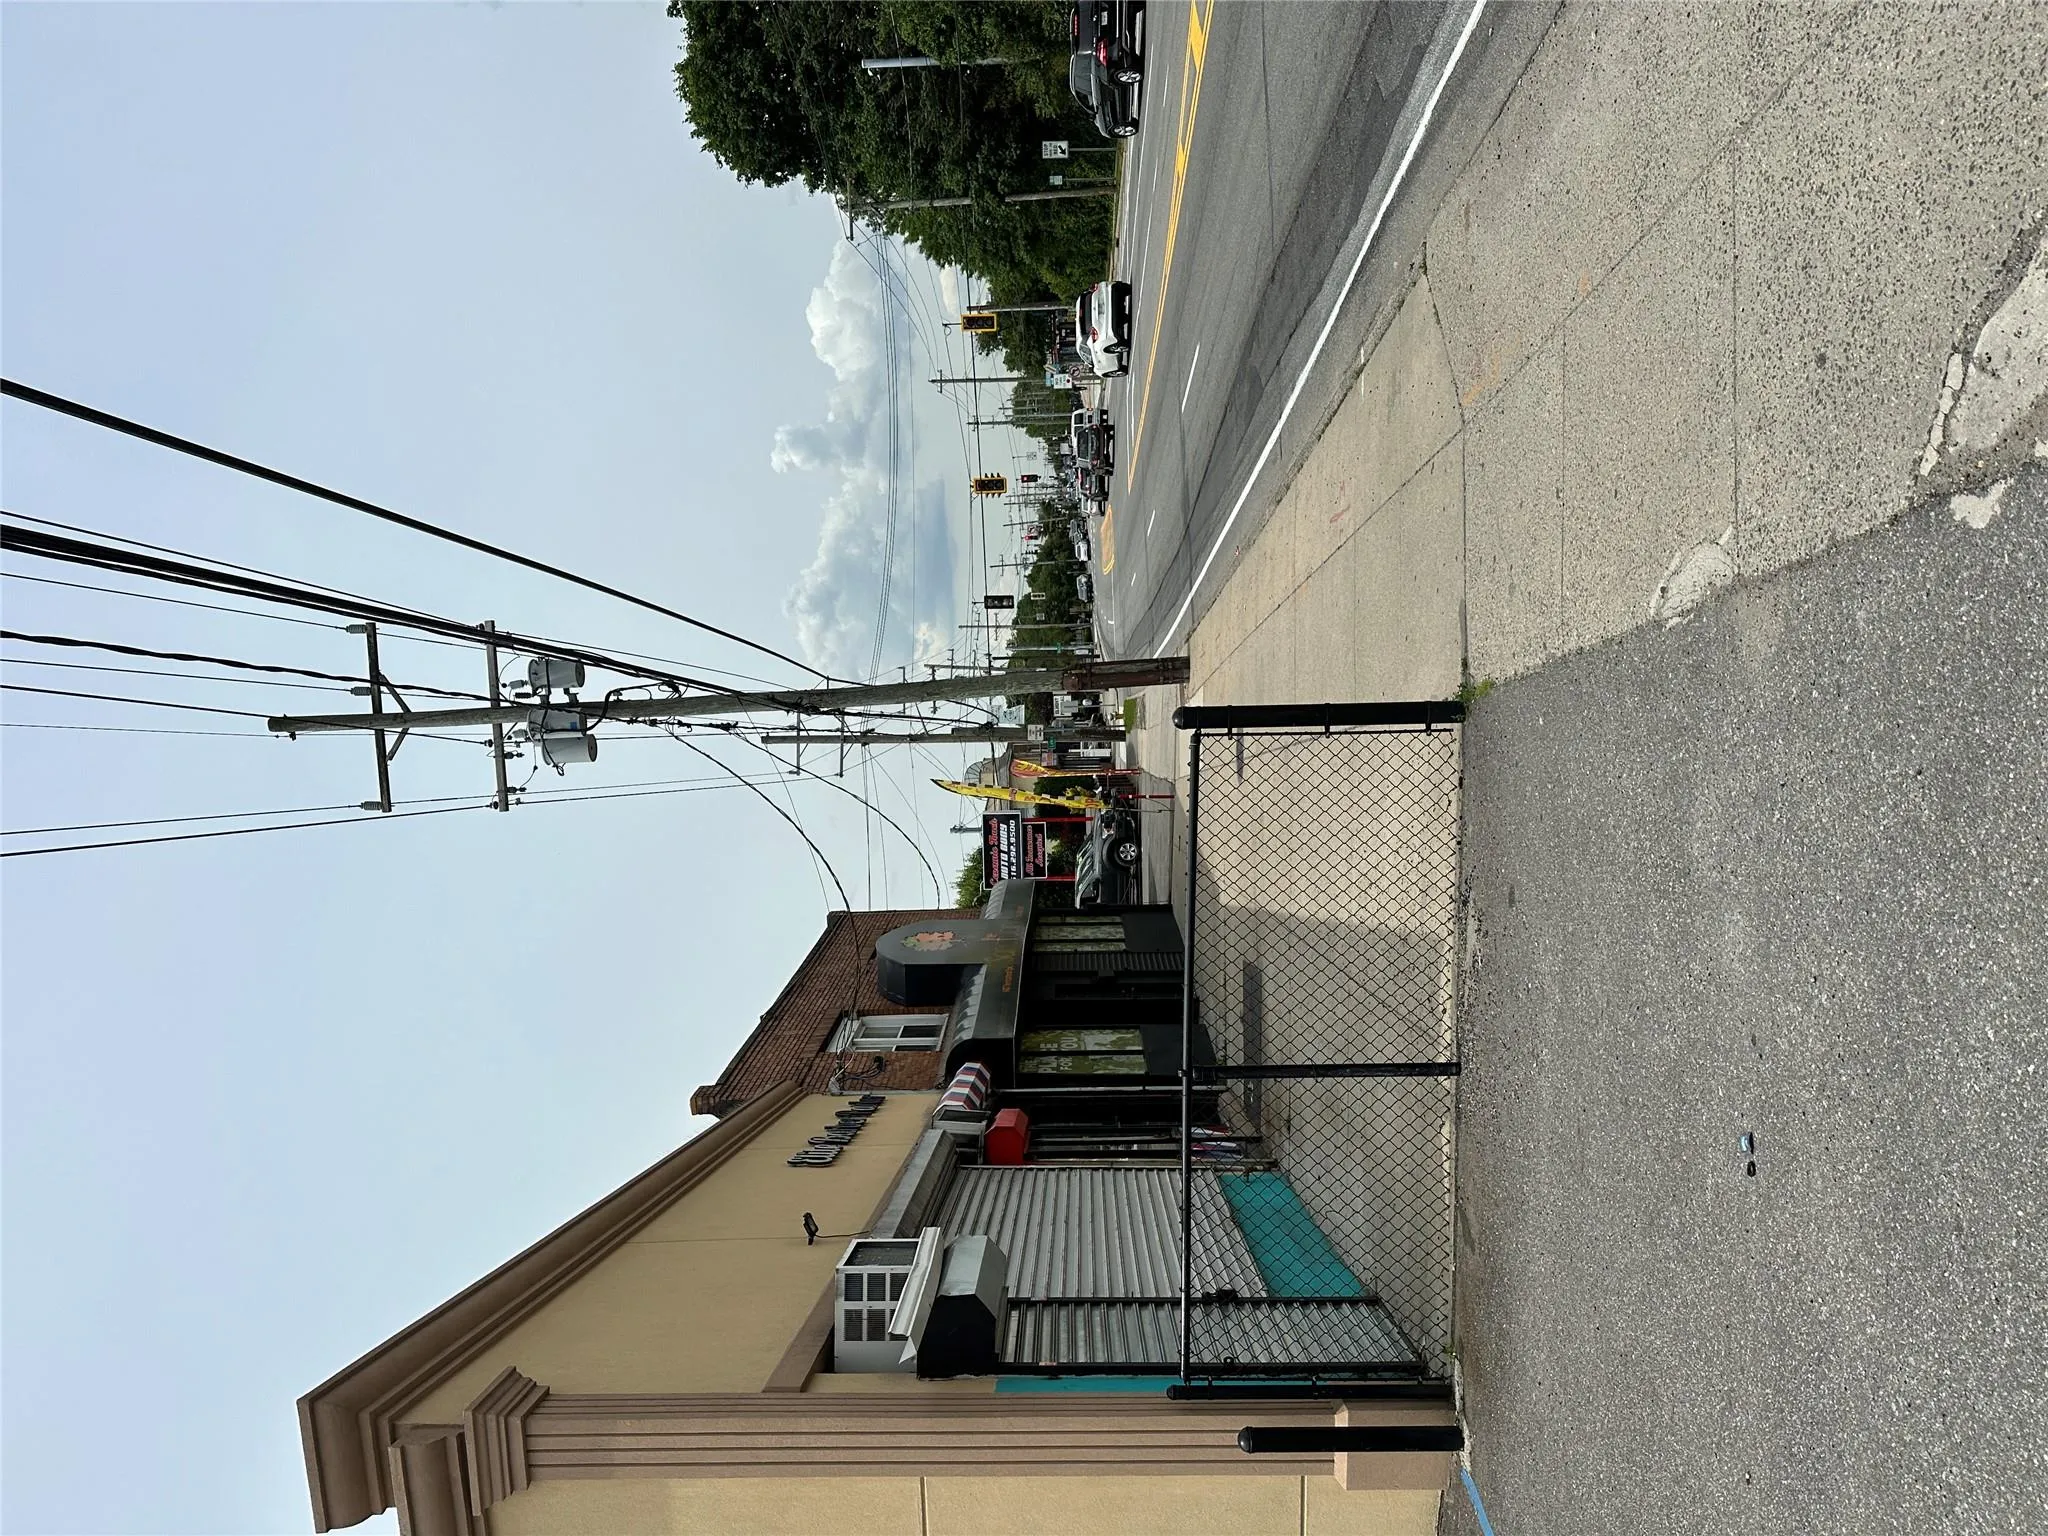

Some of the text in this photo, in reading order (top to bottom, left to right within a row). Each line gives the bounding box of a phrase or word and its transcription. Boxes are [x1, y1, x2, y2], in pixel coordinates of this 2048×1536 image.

[989, 846, 999, 886] Ceramic
[1000, 823, 1008, 880] AUTO BODY
